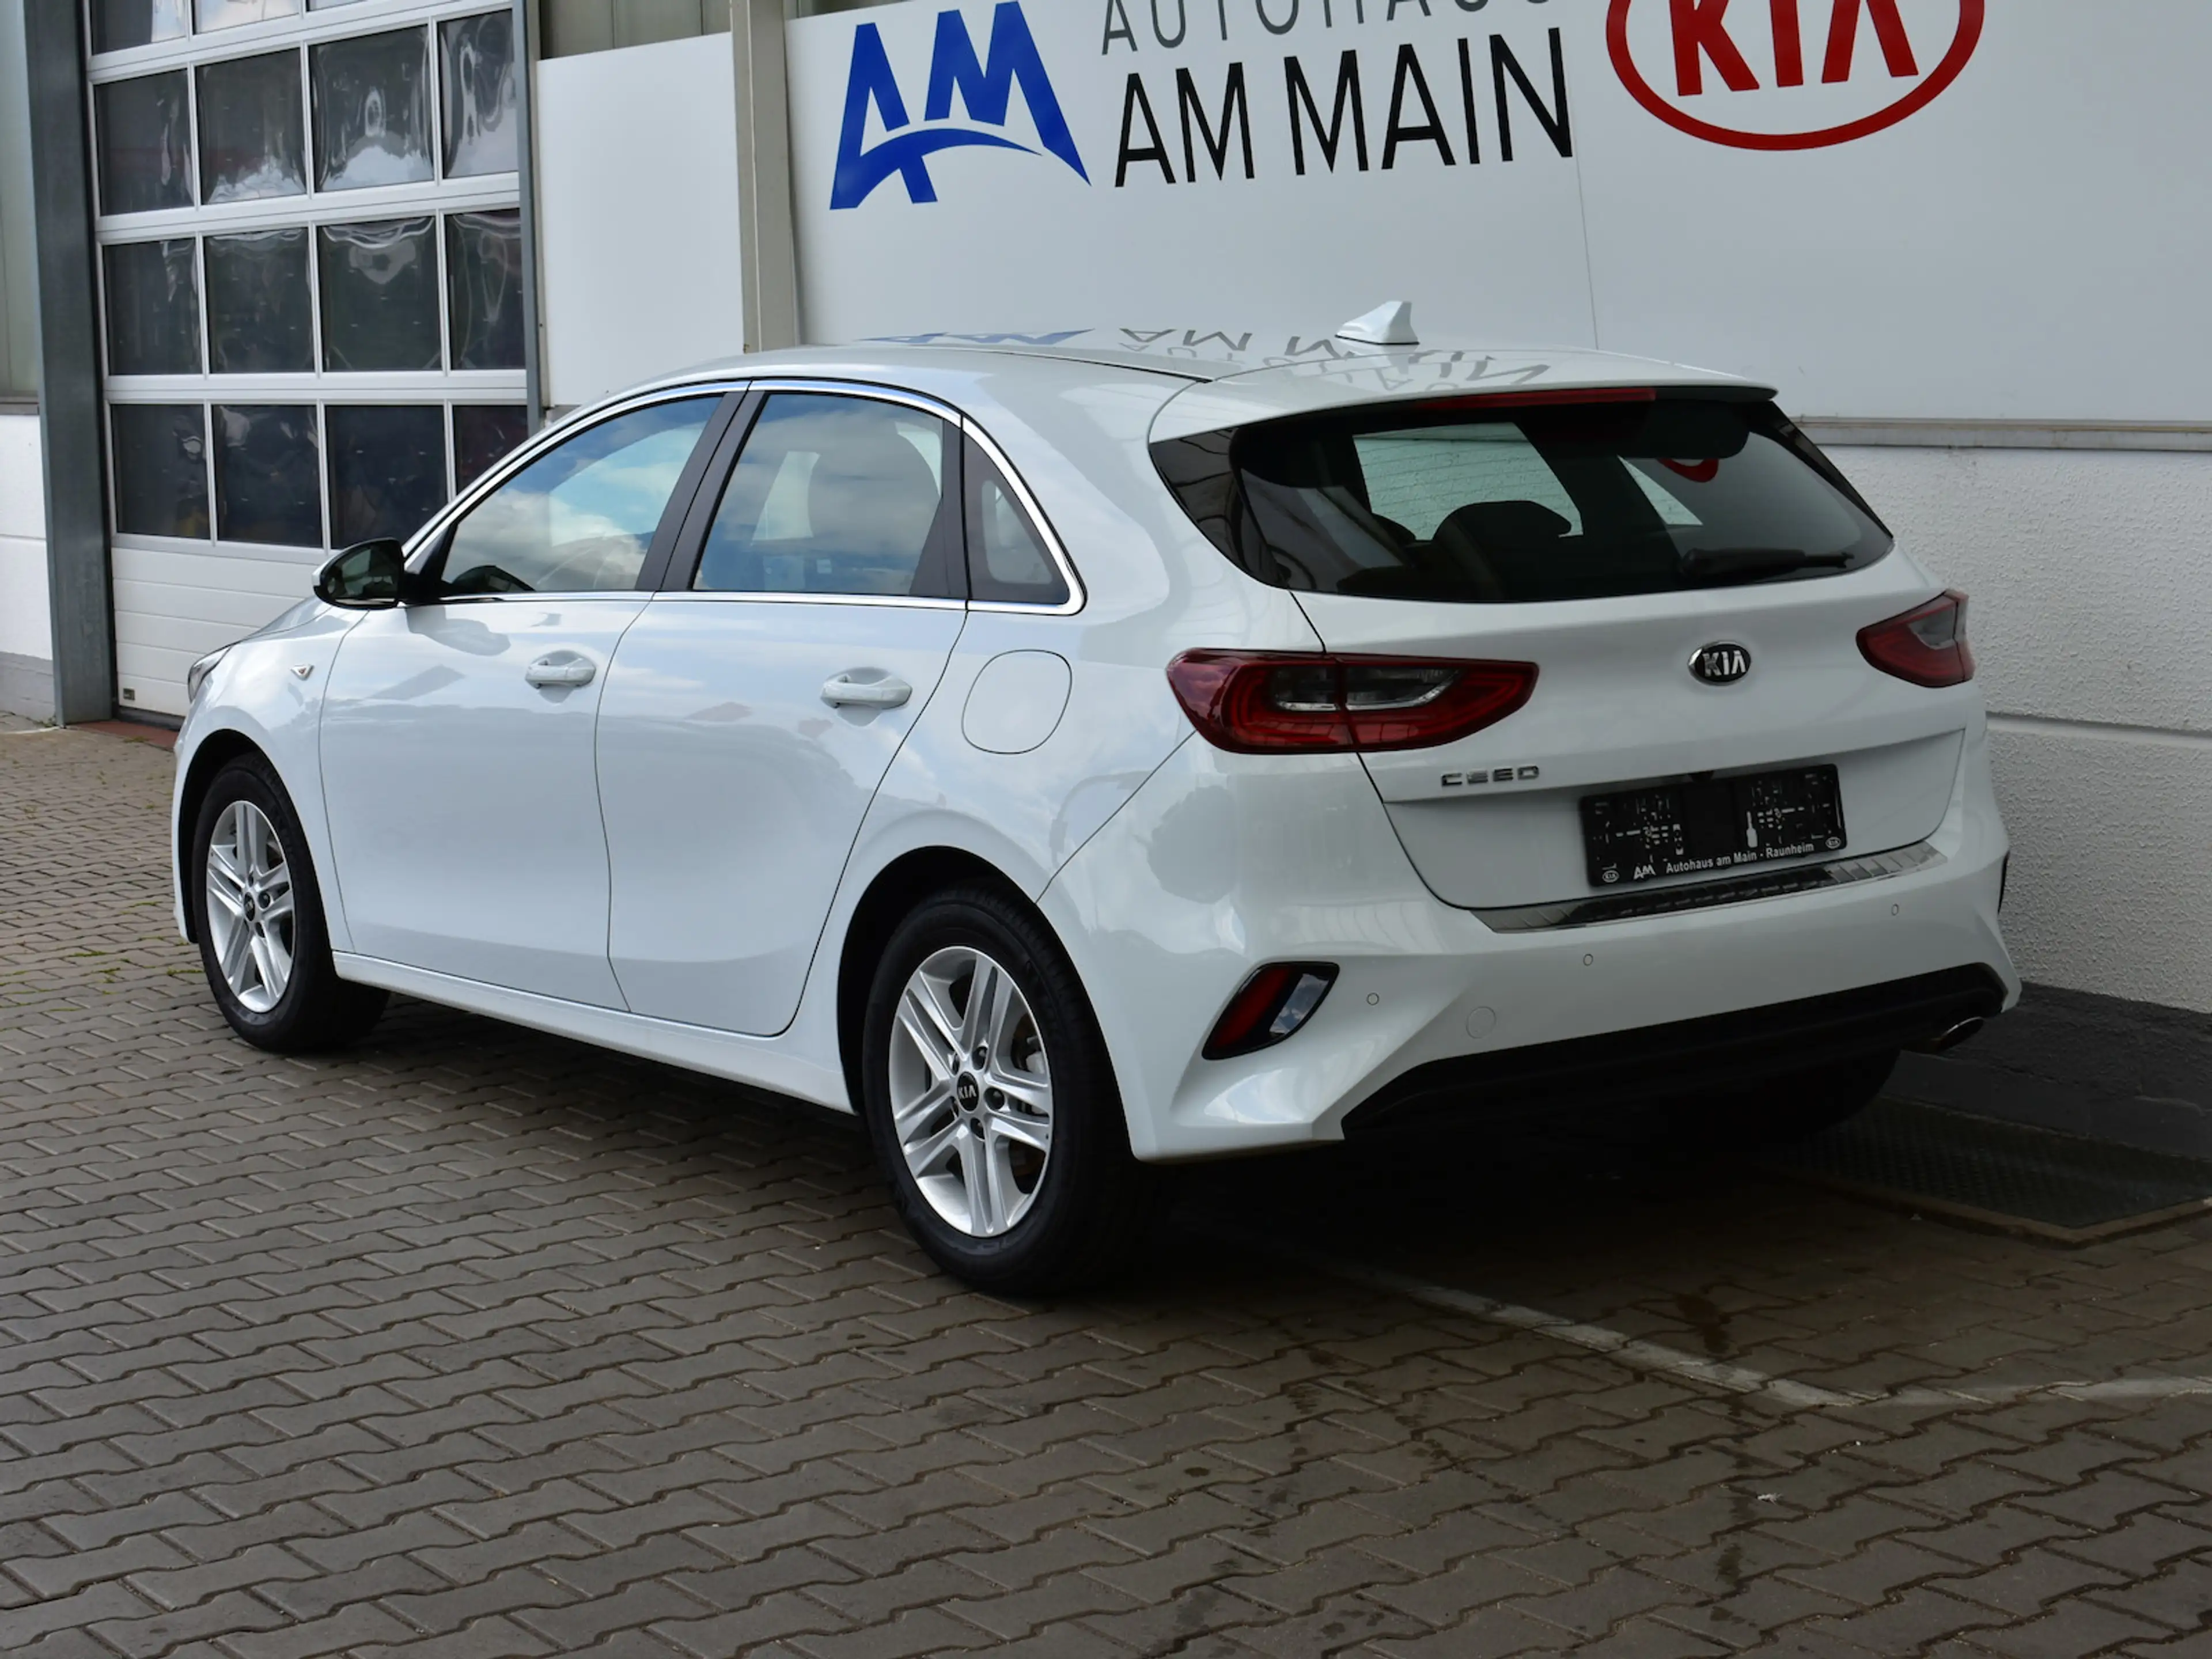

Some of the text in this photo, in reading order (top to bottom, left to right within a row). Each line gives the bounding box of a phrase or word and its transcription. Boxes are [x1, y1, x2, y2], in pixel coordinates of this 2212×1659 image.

[1668, 0, 1919, 97] KIA
[1115, 26, 1573, 188] AM MAIN
[1702, 650, 1747, 677] KIA
[1441, 765, 1540, 787] CEED
[1666, 856, 1714, 874] Autohaus
[1716, 854, 1732, 867] am
[1733, 850, 1757, 863] Main
[1766, 842, 1815, 859] Raunheim
[958, 1085, 977, 1099] KIA
